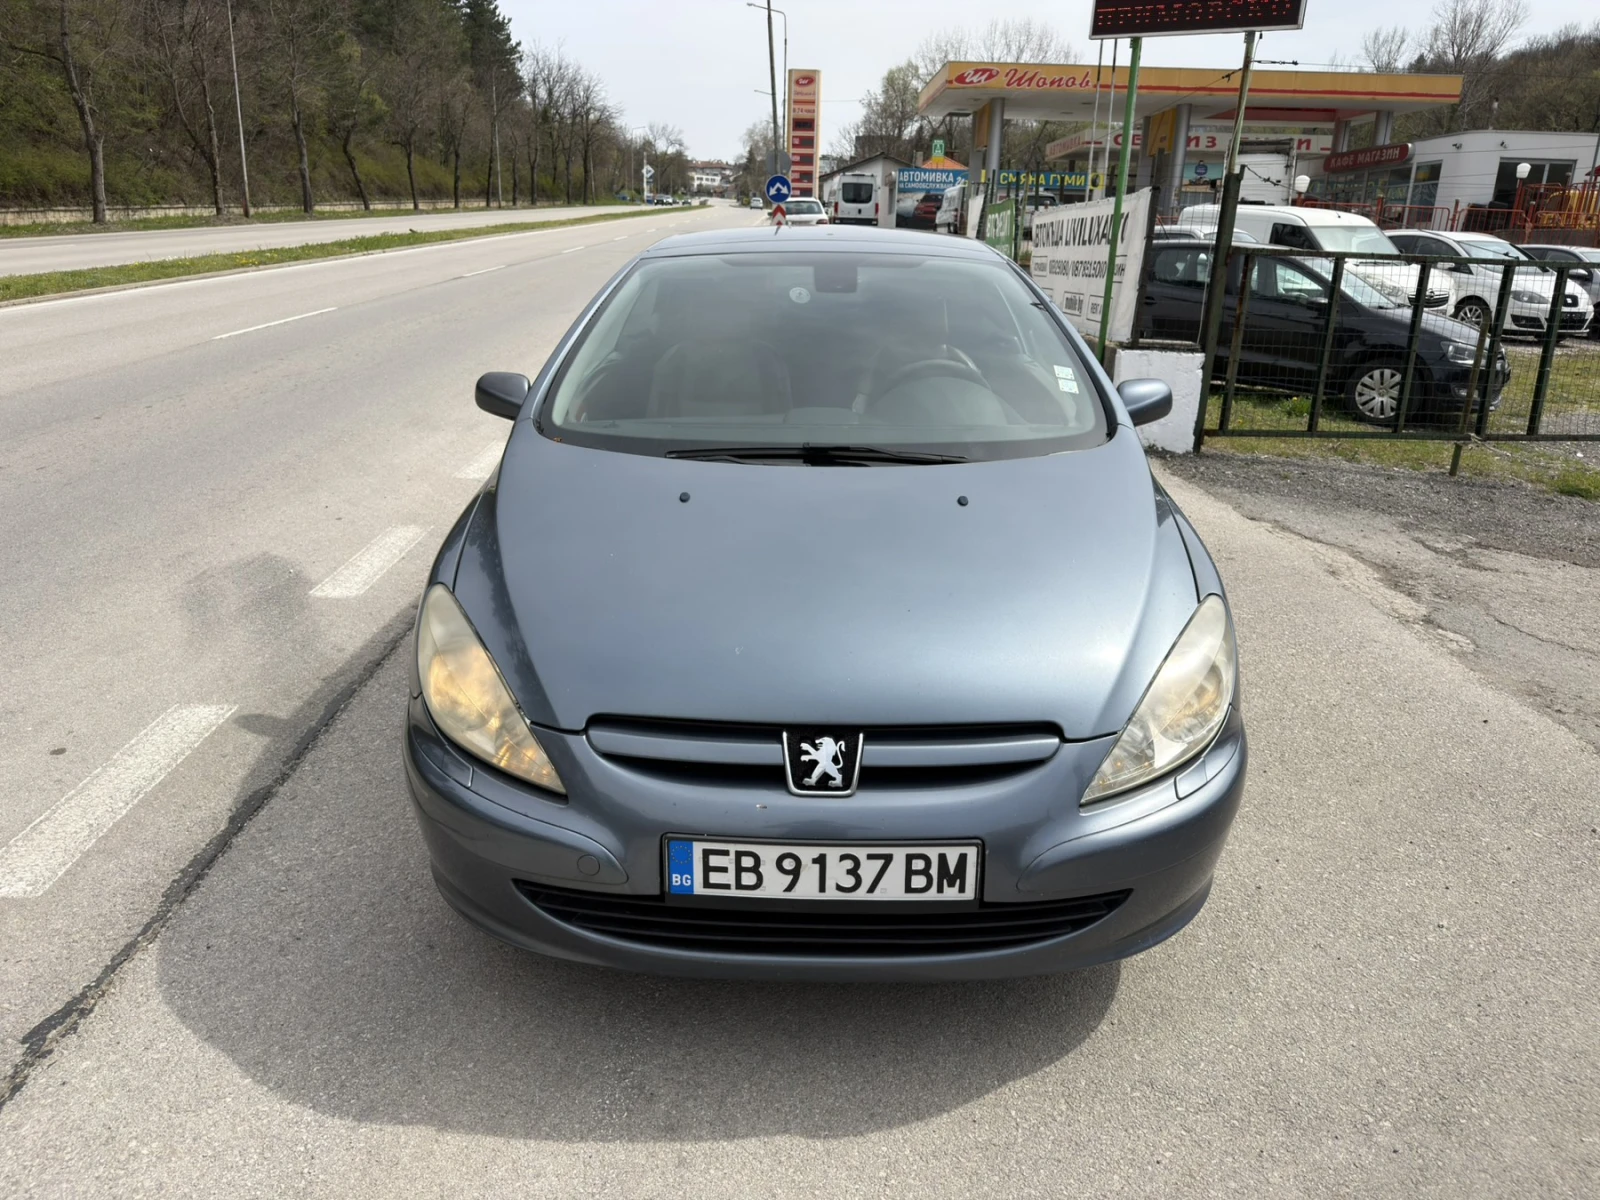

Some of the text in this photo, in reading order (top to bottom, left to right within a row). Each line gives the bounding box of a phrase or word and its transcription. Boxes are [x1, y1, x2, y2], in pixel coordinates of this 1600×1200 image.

[1113, 134, 1217, 149] СЕИЗ
[1329, 147, 1400, 169] КАФЕ МАГАЗИН
[899, 171, 954, 183] АВТОМИВКА
[1000, 172, 1085, 187] СМЯНА ГУМИ
[702, 848, 968, 894] EB 9137 BM
[672, 874, 692, 887] BG
